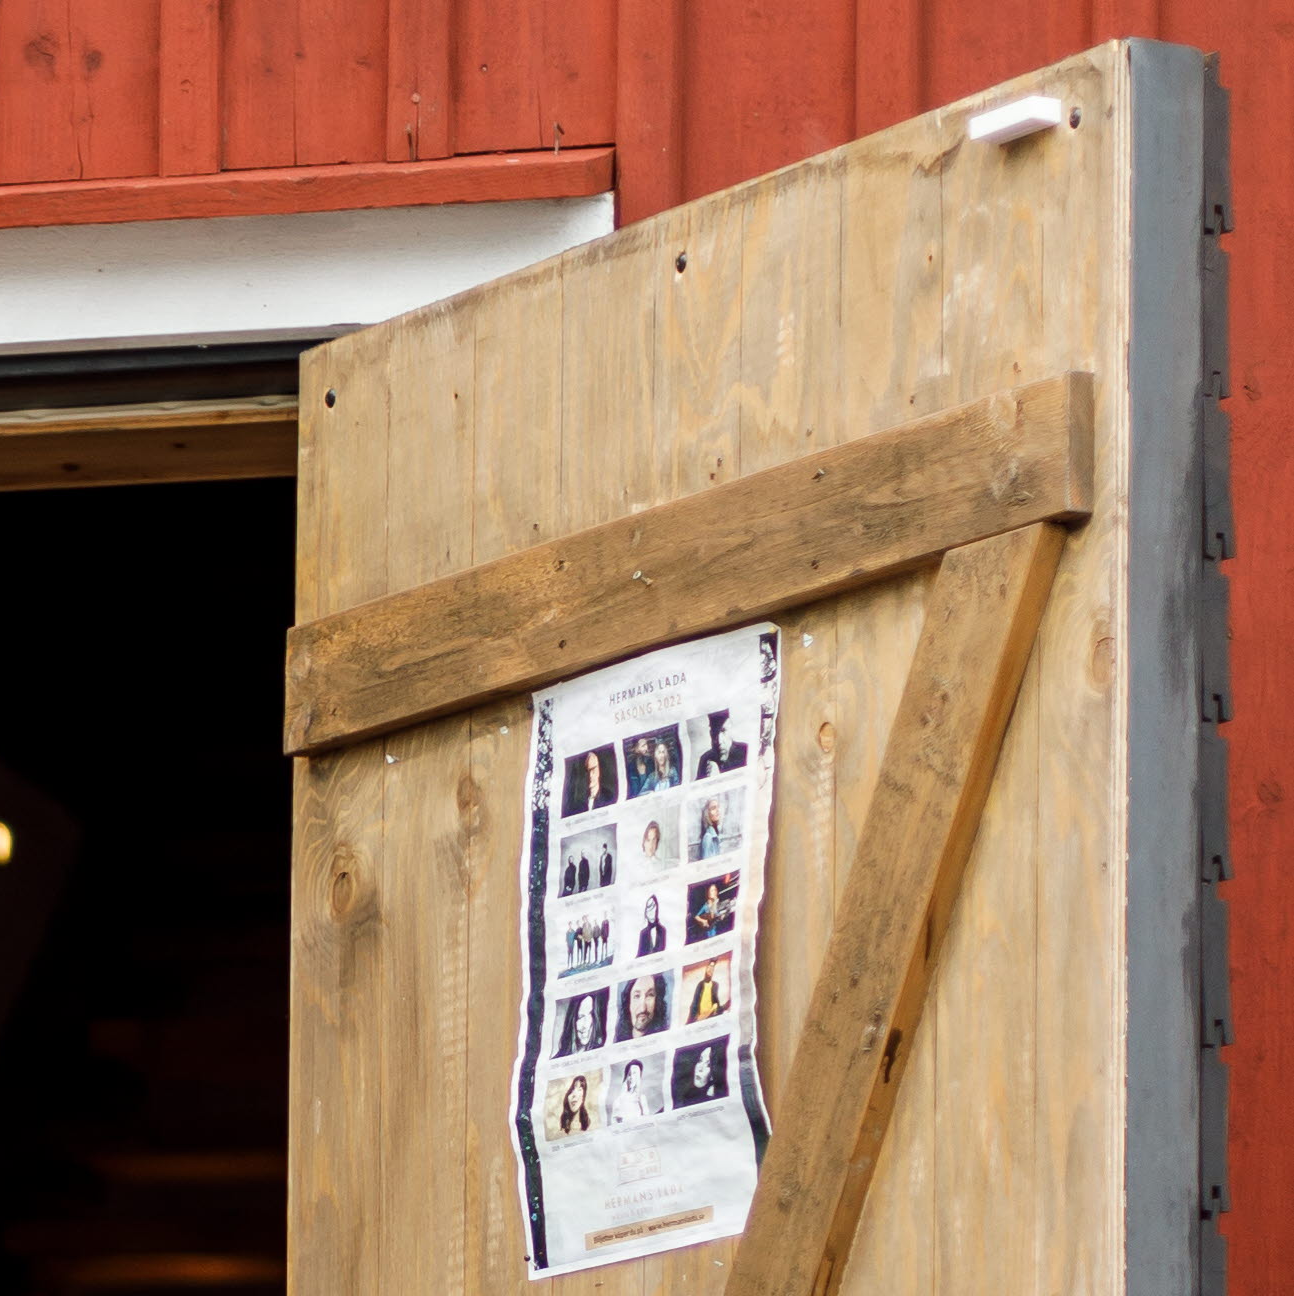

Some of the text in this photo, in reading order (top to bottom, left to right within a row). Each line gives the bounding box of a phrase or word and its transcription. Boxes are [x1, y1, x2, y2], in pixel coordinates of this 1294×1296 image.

[609, 672, 686, 705] HERMANS LADA
[657, 694, 682, 711] 2022
